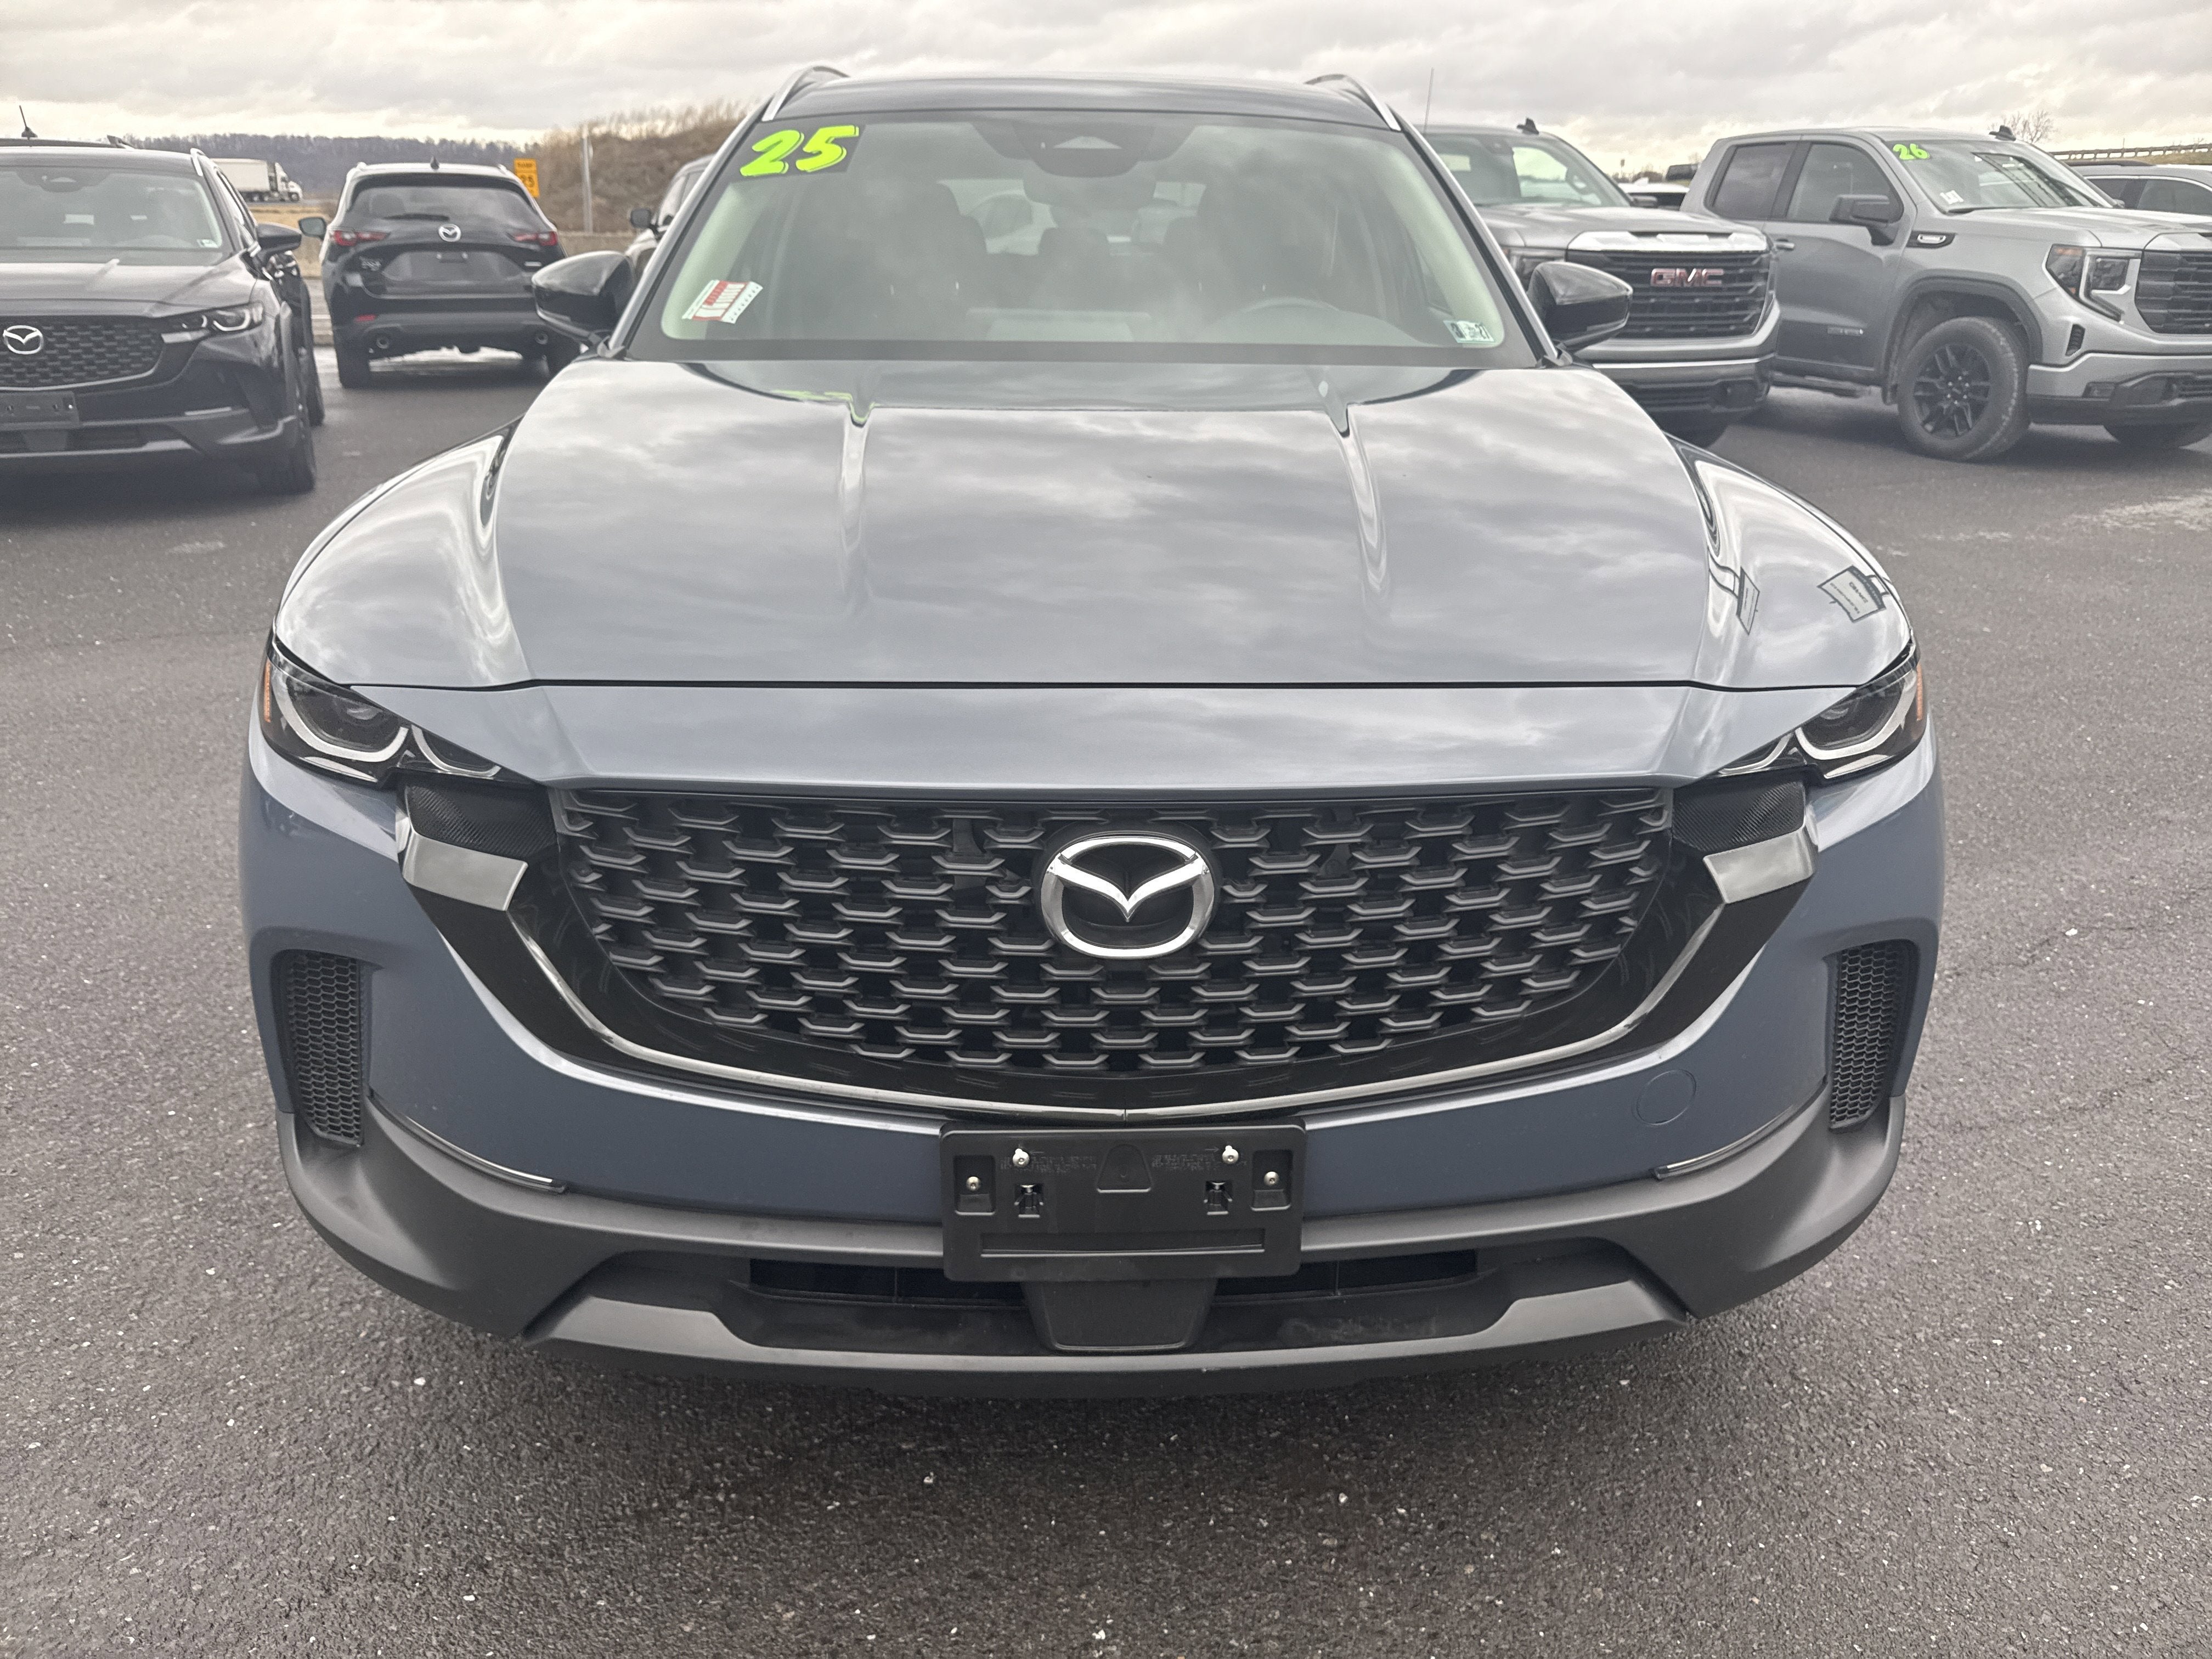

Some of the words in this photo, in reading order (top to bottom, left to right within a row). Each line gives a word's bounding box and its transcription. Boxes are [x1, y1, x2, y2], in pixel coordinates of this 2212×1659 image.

[740, 125, 860, 177] 25
[1893, 143, 1930, 160] 26
[1651, 268, 1724, 287] GMC
